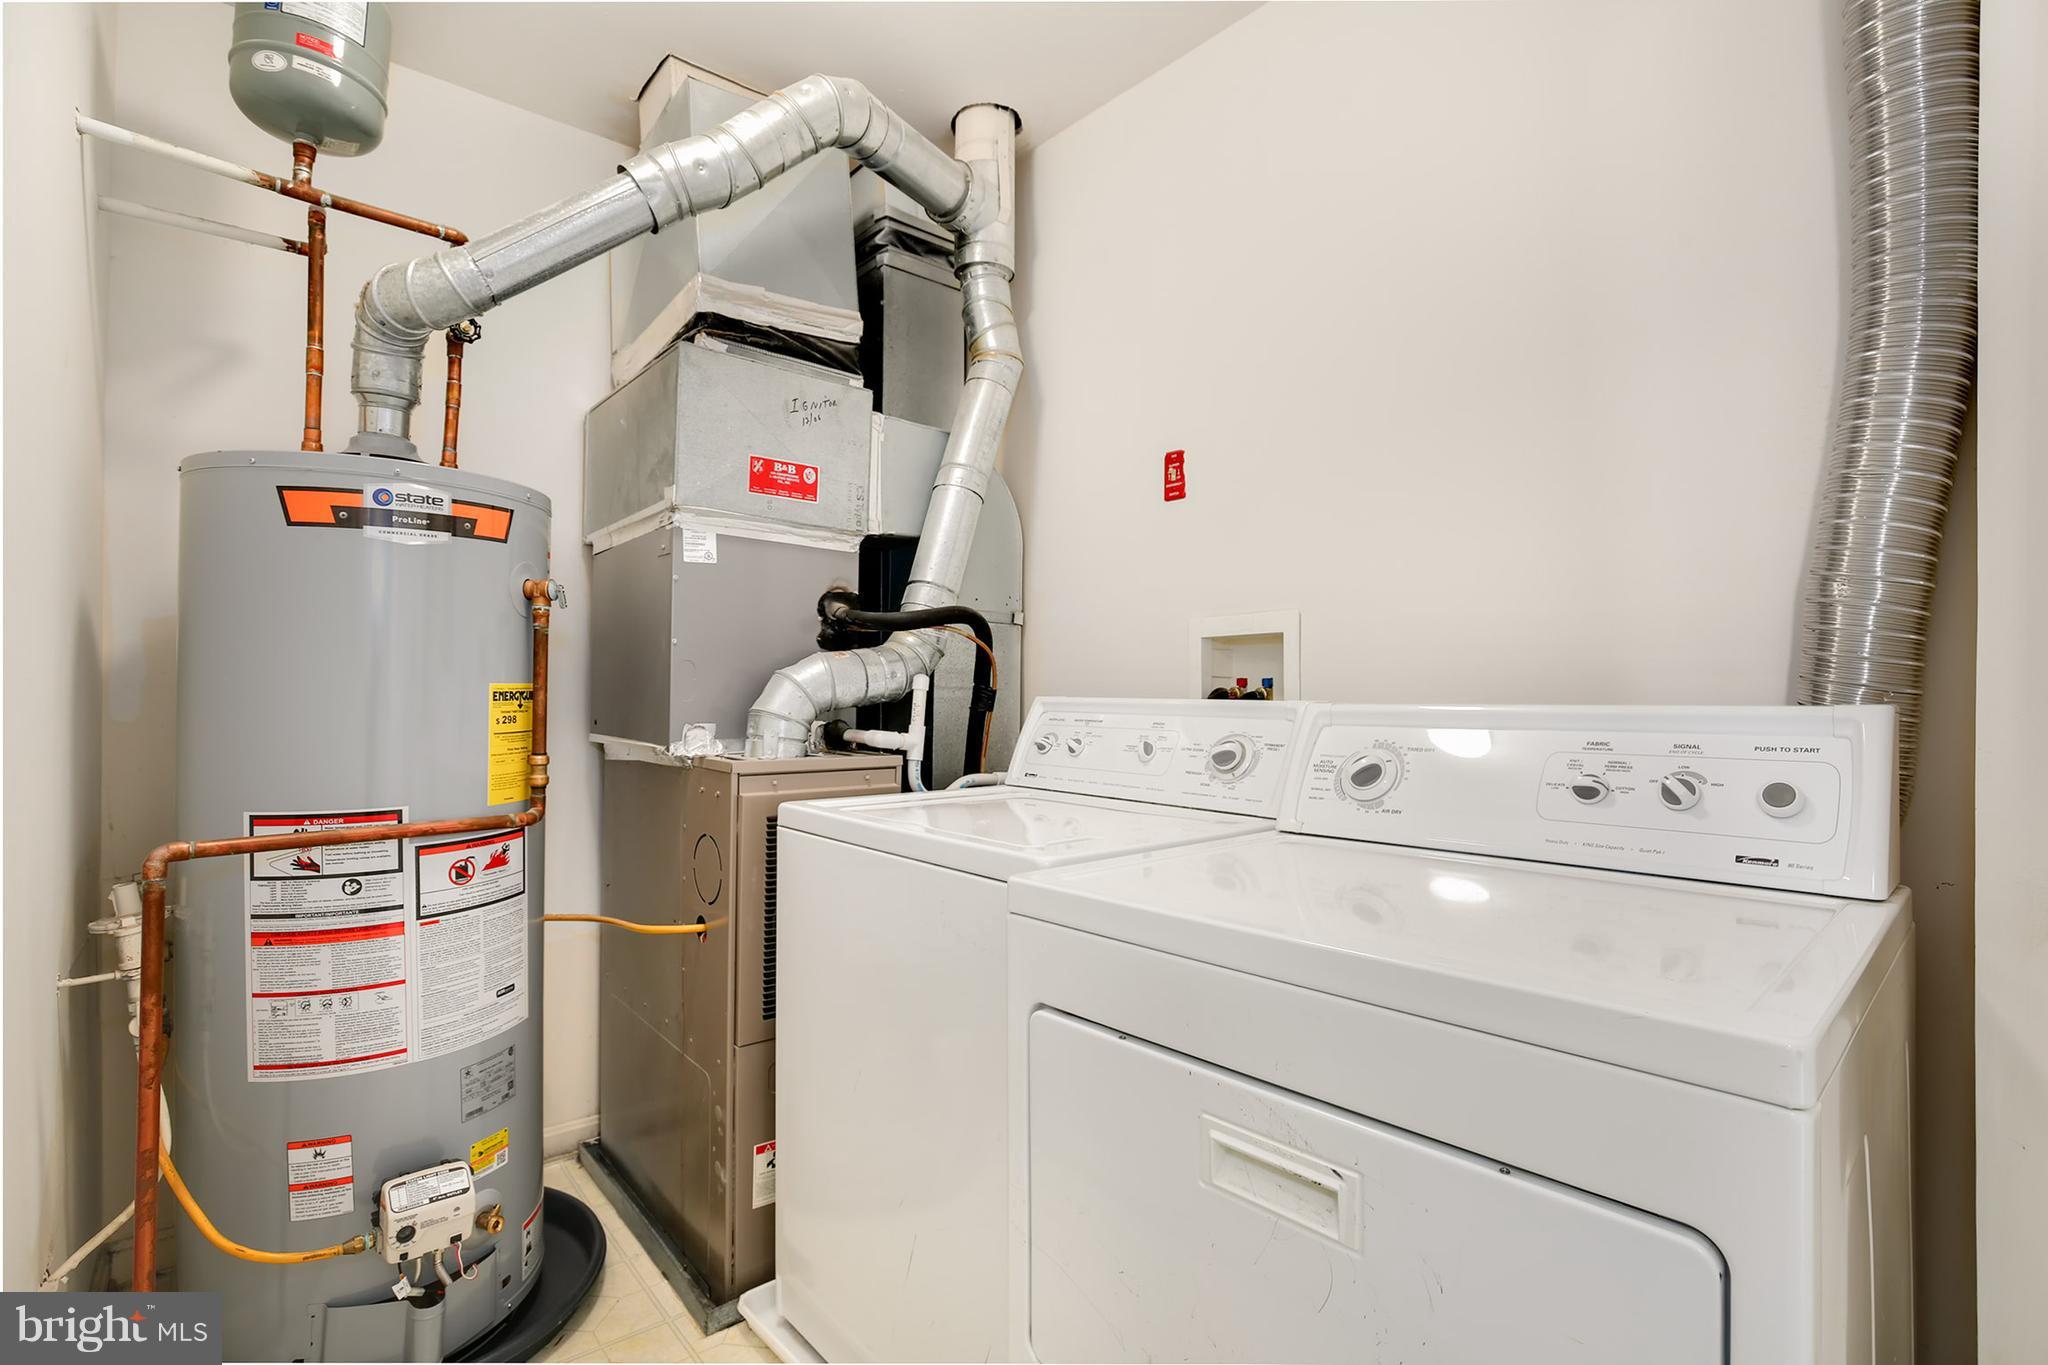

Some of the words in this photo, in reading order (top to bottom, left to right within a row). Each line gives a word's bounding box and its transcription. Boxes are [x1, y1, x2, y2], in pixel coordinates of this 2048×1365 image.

[773, 462, 797, 475] B&B
[395, 492, 444, 507] state
[392, 515, 428, 526] ProLine
[502, 715, 517, 724] 298
